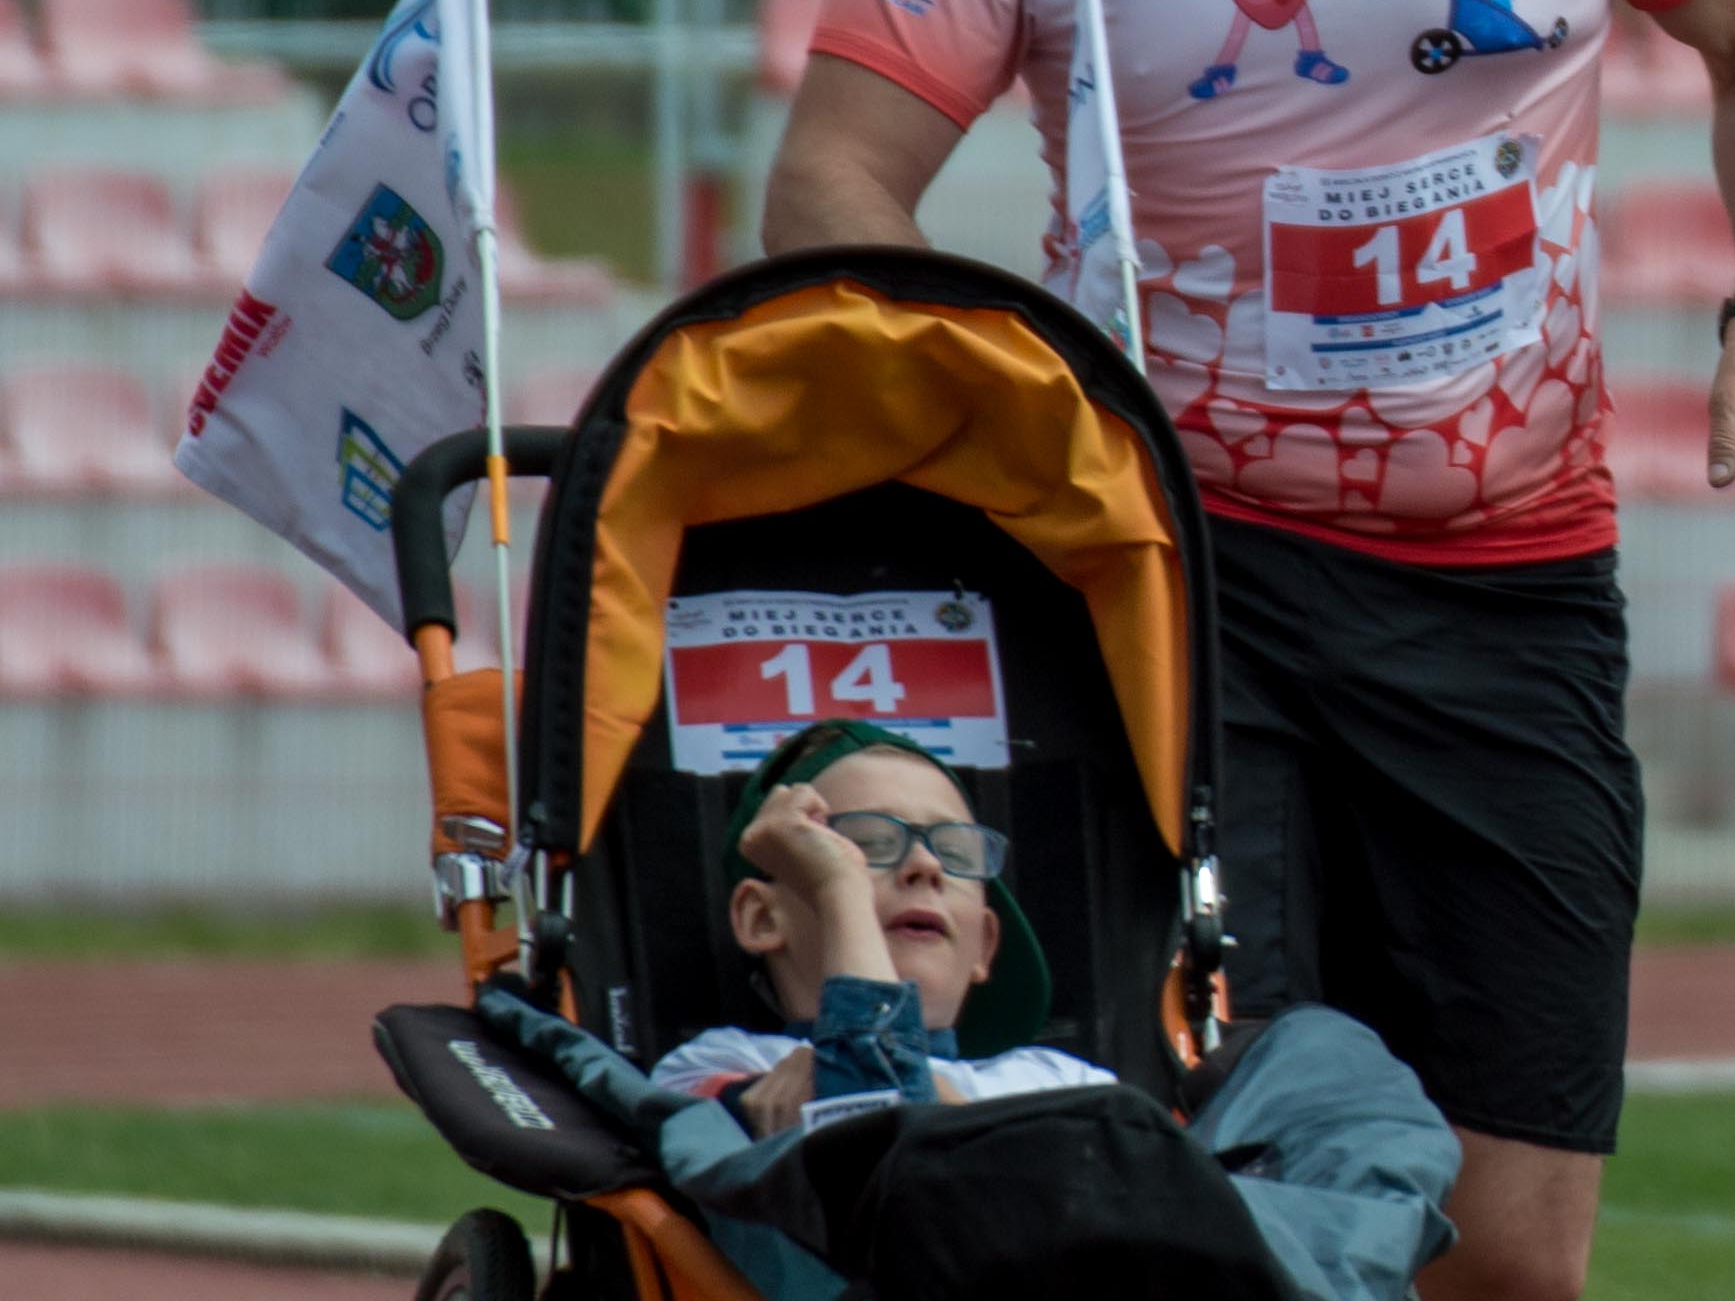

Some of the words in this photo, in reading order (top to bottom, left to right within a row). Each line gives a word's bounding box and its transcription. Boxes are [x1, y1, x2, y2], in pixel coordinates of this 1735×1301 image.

[1317, 207, 1355, 222] DO
[1365, 179, 1487, 218] BIEGANIA
[1324, 185, 1392, 205] MIEJ
[1404, 163, 1478, 195] SERCE
[1352, 207, 1478, 306] 14
[721, 624, 760, 638] DO
[772, 623, 919, 639] BIEGANIA
[728, 607, 799, 623] MIEJ
[814, 607, 907, 625] SERCE
[760, 642, 907, 716] 14
